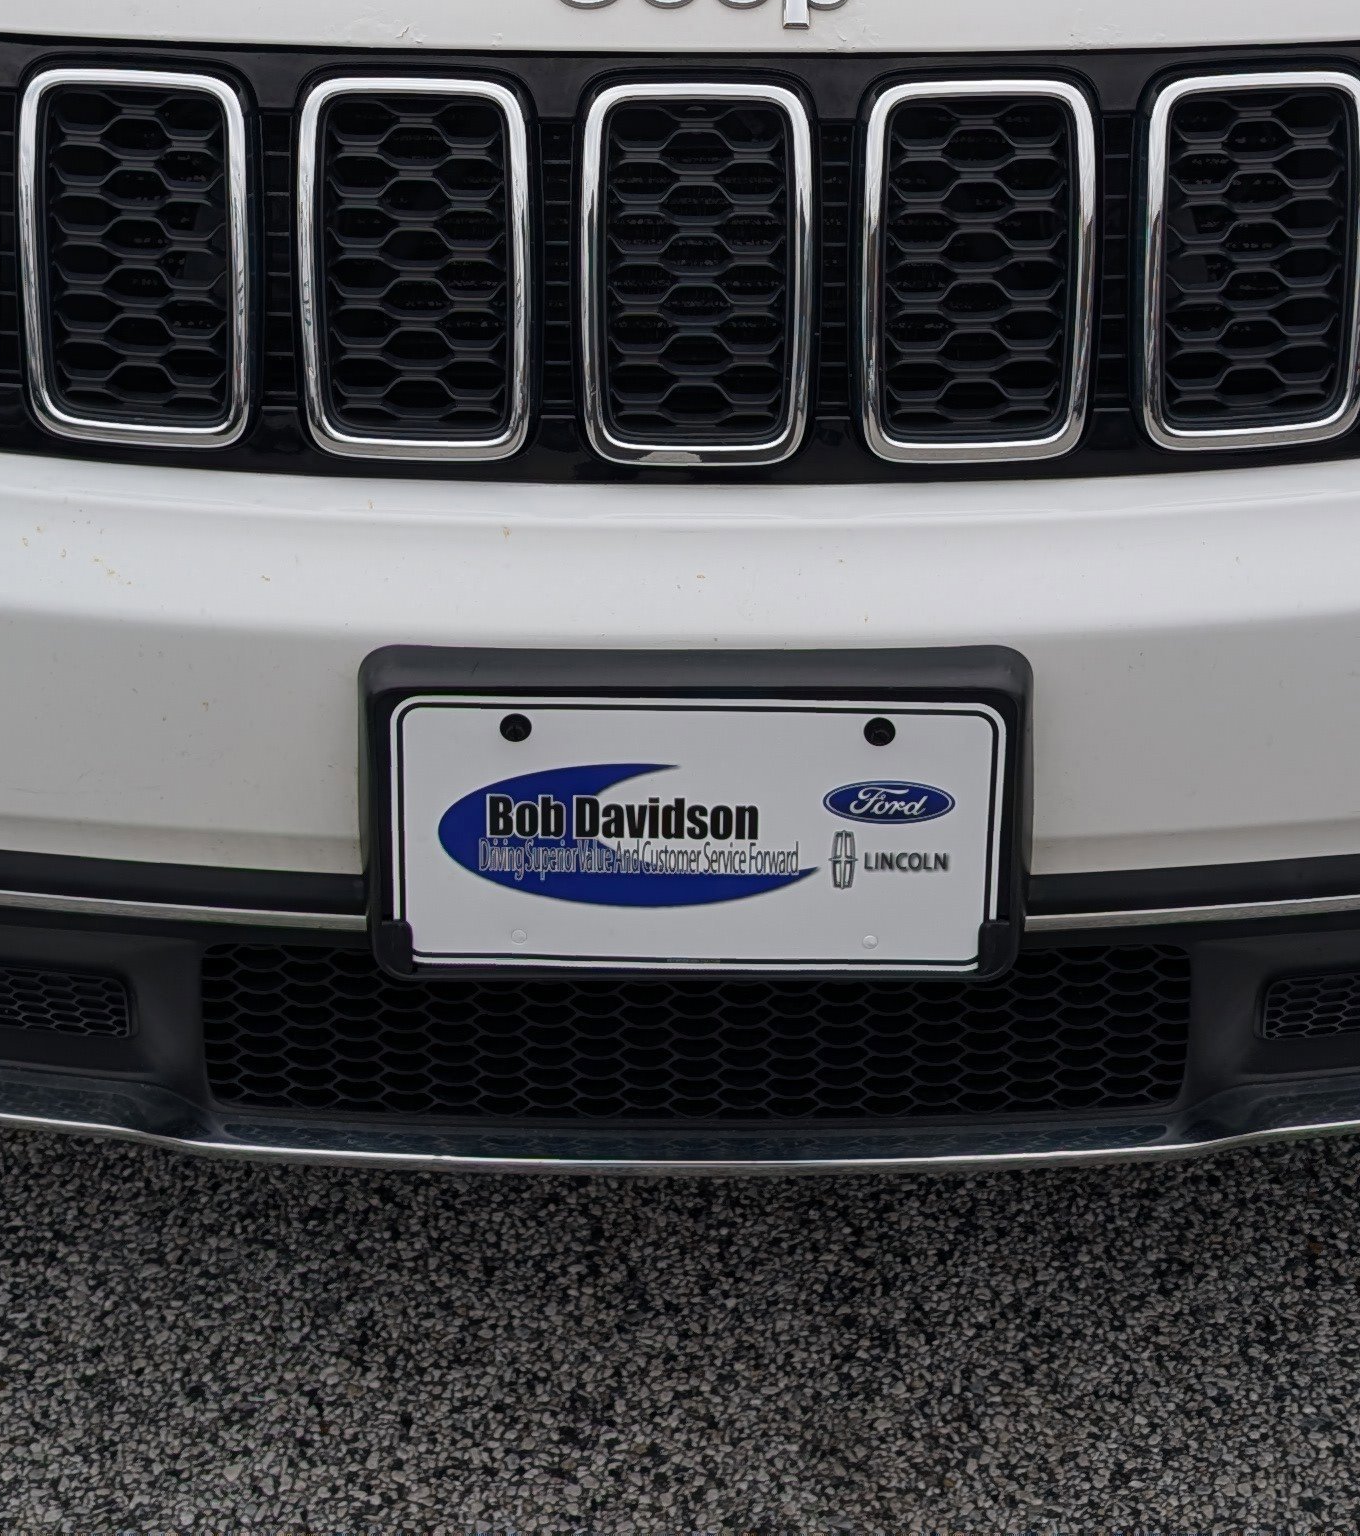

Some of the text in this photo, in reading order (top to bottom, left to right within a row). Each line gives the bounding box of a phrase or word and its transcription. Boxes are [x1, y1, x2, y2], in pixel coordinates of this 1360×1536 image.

[487, 794, 759, 840] Bob Davidson
[849, 786, 928, 815] Ford
[479, 838, 799, 880] Driving Superior Value And Customer Service Forward
[864, 851, 949, 872] LINCOLN
